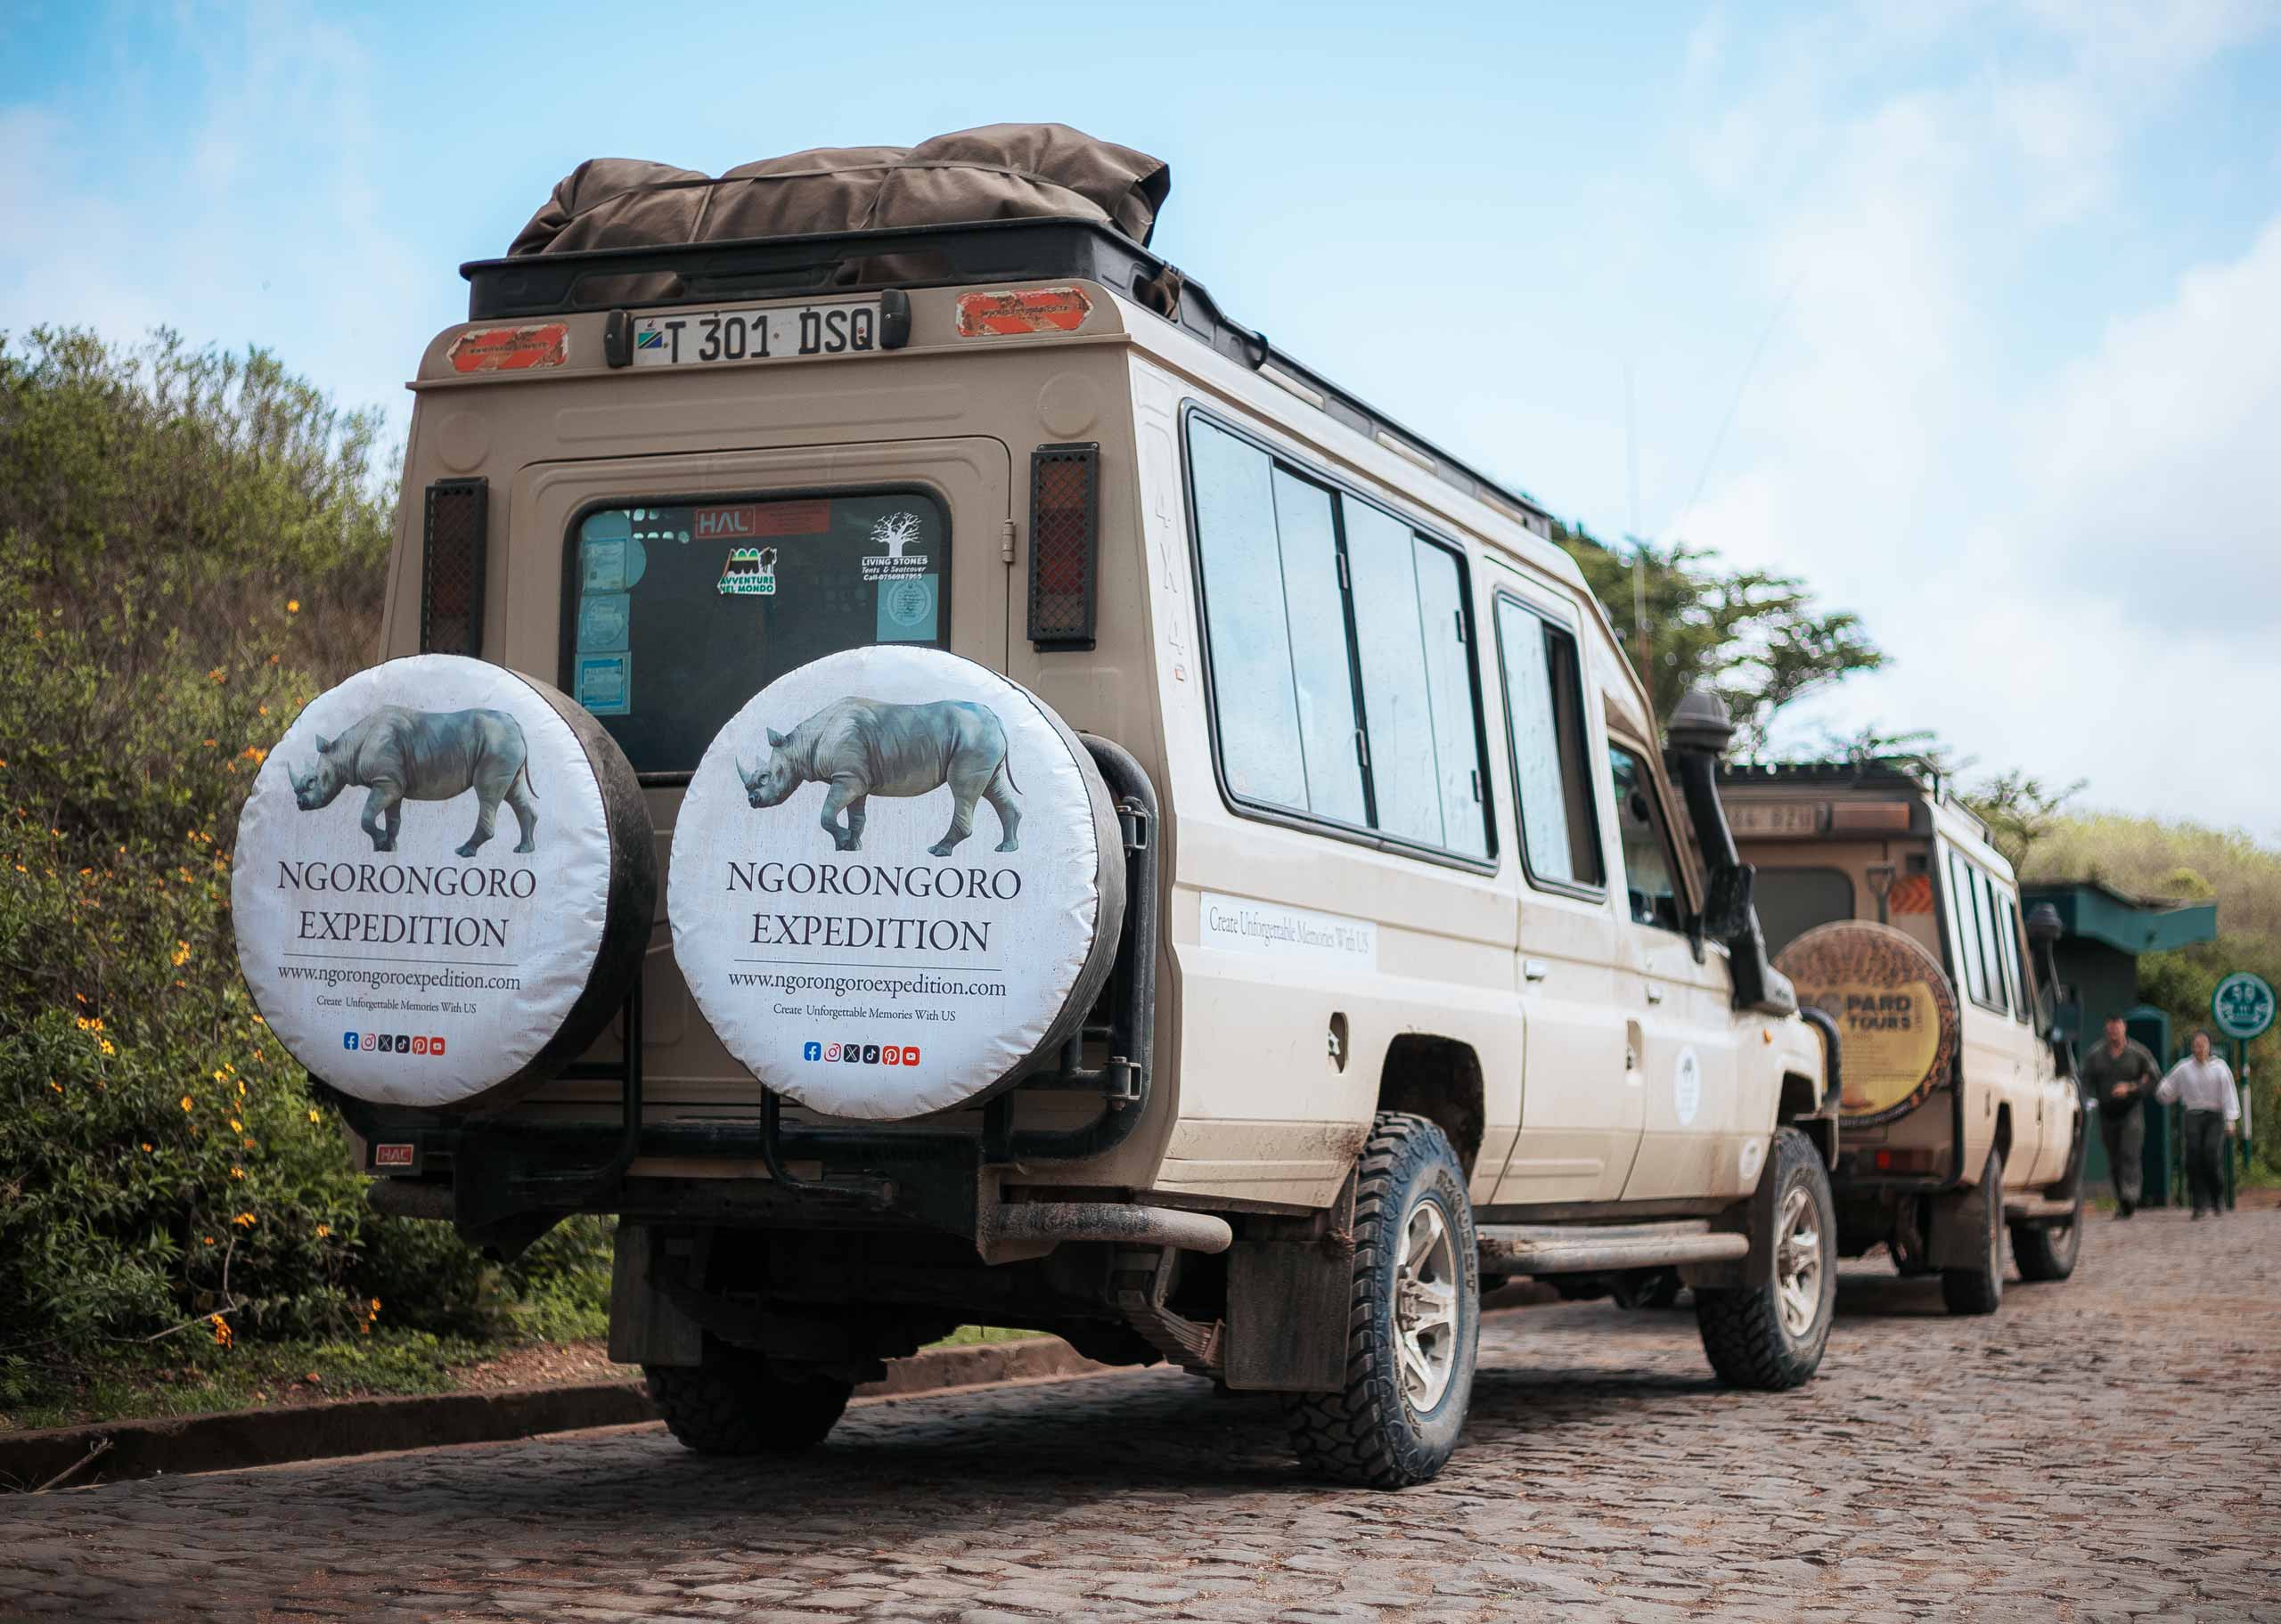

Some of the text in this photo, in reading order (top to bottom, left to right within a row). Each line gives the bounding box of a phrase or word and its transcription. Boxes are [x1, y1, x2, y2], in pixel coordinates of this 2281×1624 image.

[665, 308, 874, 363] T 301 DSQ
[699, 510, 749, 534] HAL
[893, 557, 928, 565] STONES
[720, 575, 774, 584] AVVENTURE
[738, 584, 774, 592] MONDO
[277, 861, 536, 898] NGORONGORO
[726, 861, 1021, 900] NGORONGORO
[298, 910, 510, 948] EXPEDITION
[749, 912, 992, 952] EXPEDITION
[1209, 905, 1239, 934] Create
[1240, 910, 1295, 946] Unforgettable
[1296, 920, 1336, 948] Memories
[277, 966, 520, 992] www.ngorongoroexpedition.com
[728, 972, 1006, 999] www.ngorongoroexpedition.com
[316, 994, 477, 1014] Create Unforgettable Memories With US
[773, 1003, 956, 1022] Create Unforgettable Memories With US
[380, 1147, 408, 1162] HAL
